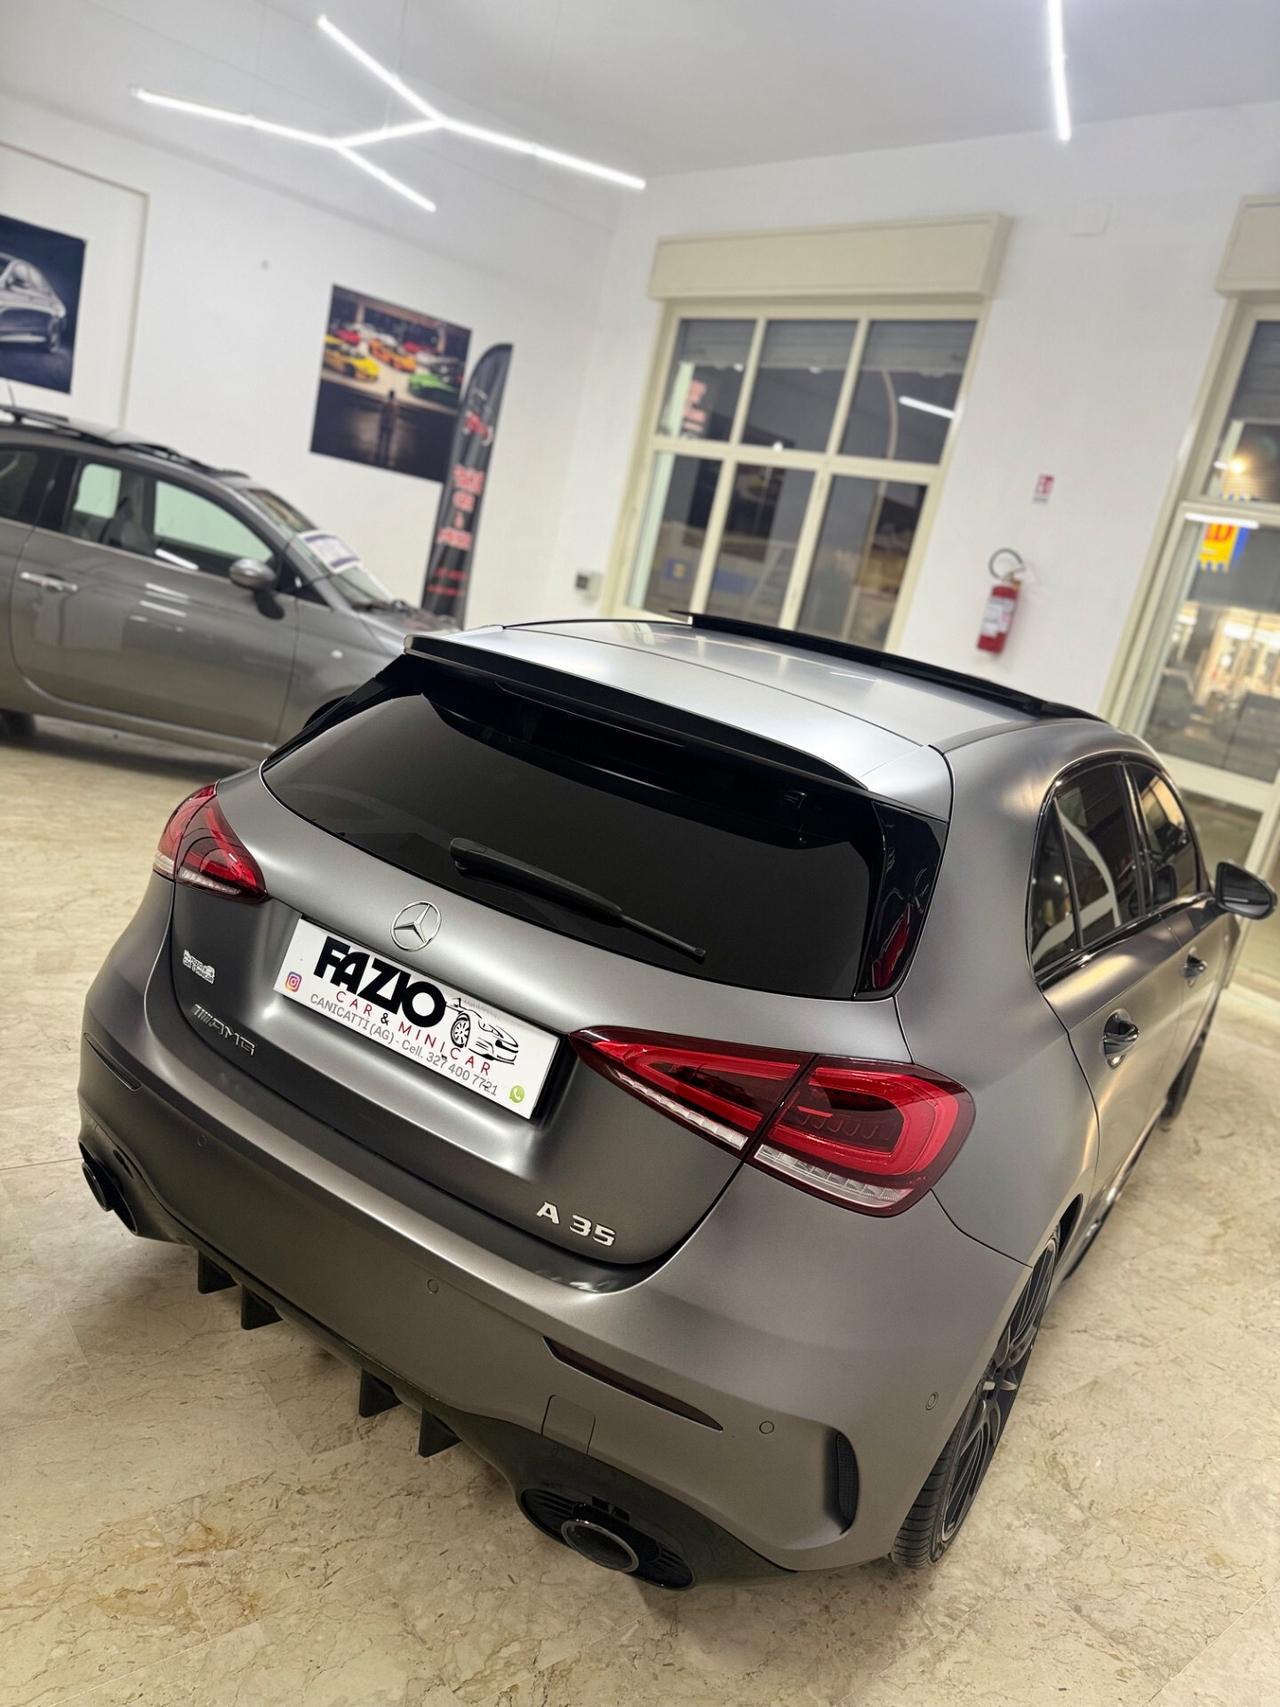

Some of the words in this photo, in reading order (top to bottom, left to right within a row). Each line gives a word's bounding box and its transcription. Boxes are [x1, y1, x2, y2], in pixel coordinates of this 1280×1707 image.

[313, 935, 447, 1028] FAZIO
[336, 990, 373, 1017] CAR
[380, 1012, 389, 1026] &
[401, 1039, 423, 1059] Cell.
[426, 1051, 448, 1069] 327
[448, 1063, 470, 1081] 400
[472, 1073, 498, 1096] 7721
[536, 1201, 560, 1225] A
[569, 1214, 616, 1247] 35
